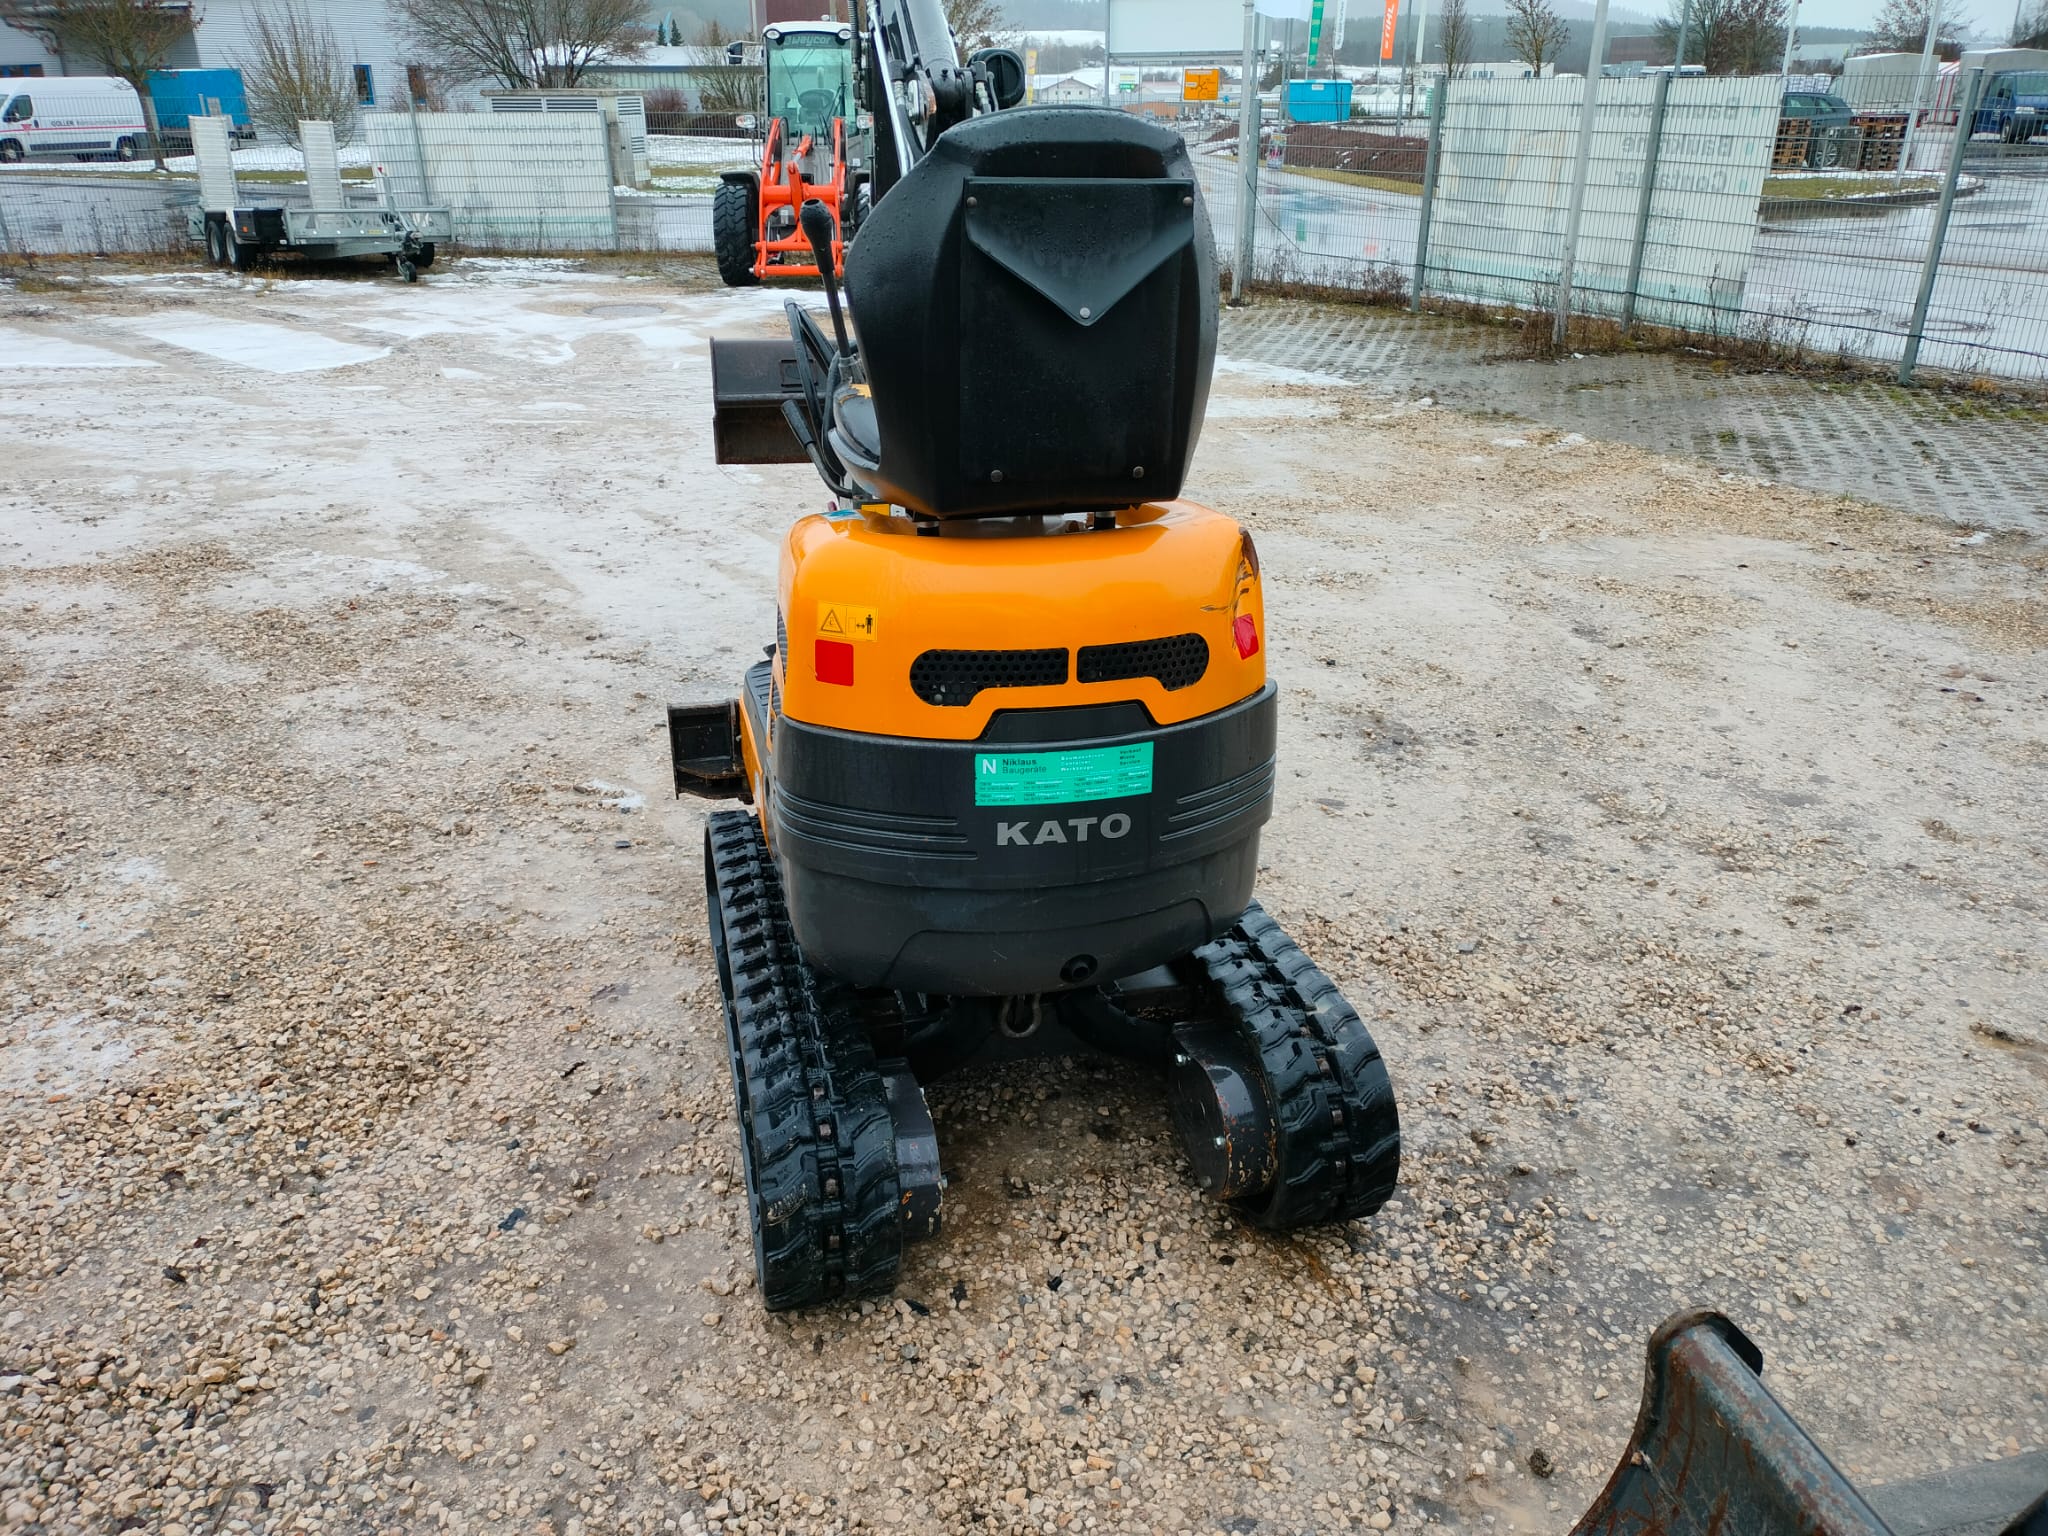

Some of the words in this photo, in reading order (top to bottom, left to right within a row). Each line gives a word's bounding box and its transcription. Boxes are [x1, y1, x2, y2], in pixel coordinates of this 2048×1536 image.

[792, 35, 831, 47] weycor
[982, 758, 997, 775] N
[1002, 758, 1037, 767] Niklaus
[996, 813, 1131, 846] KATO
